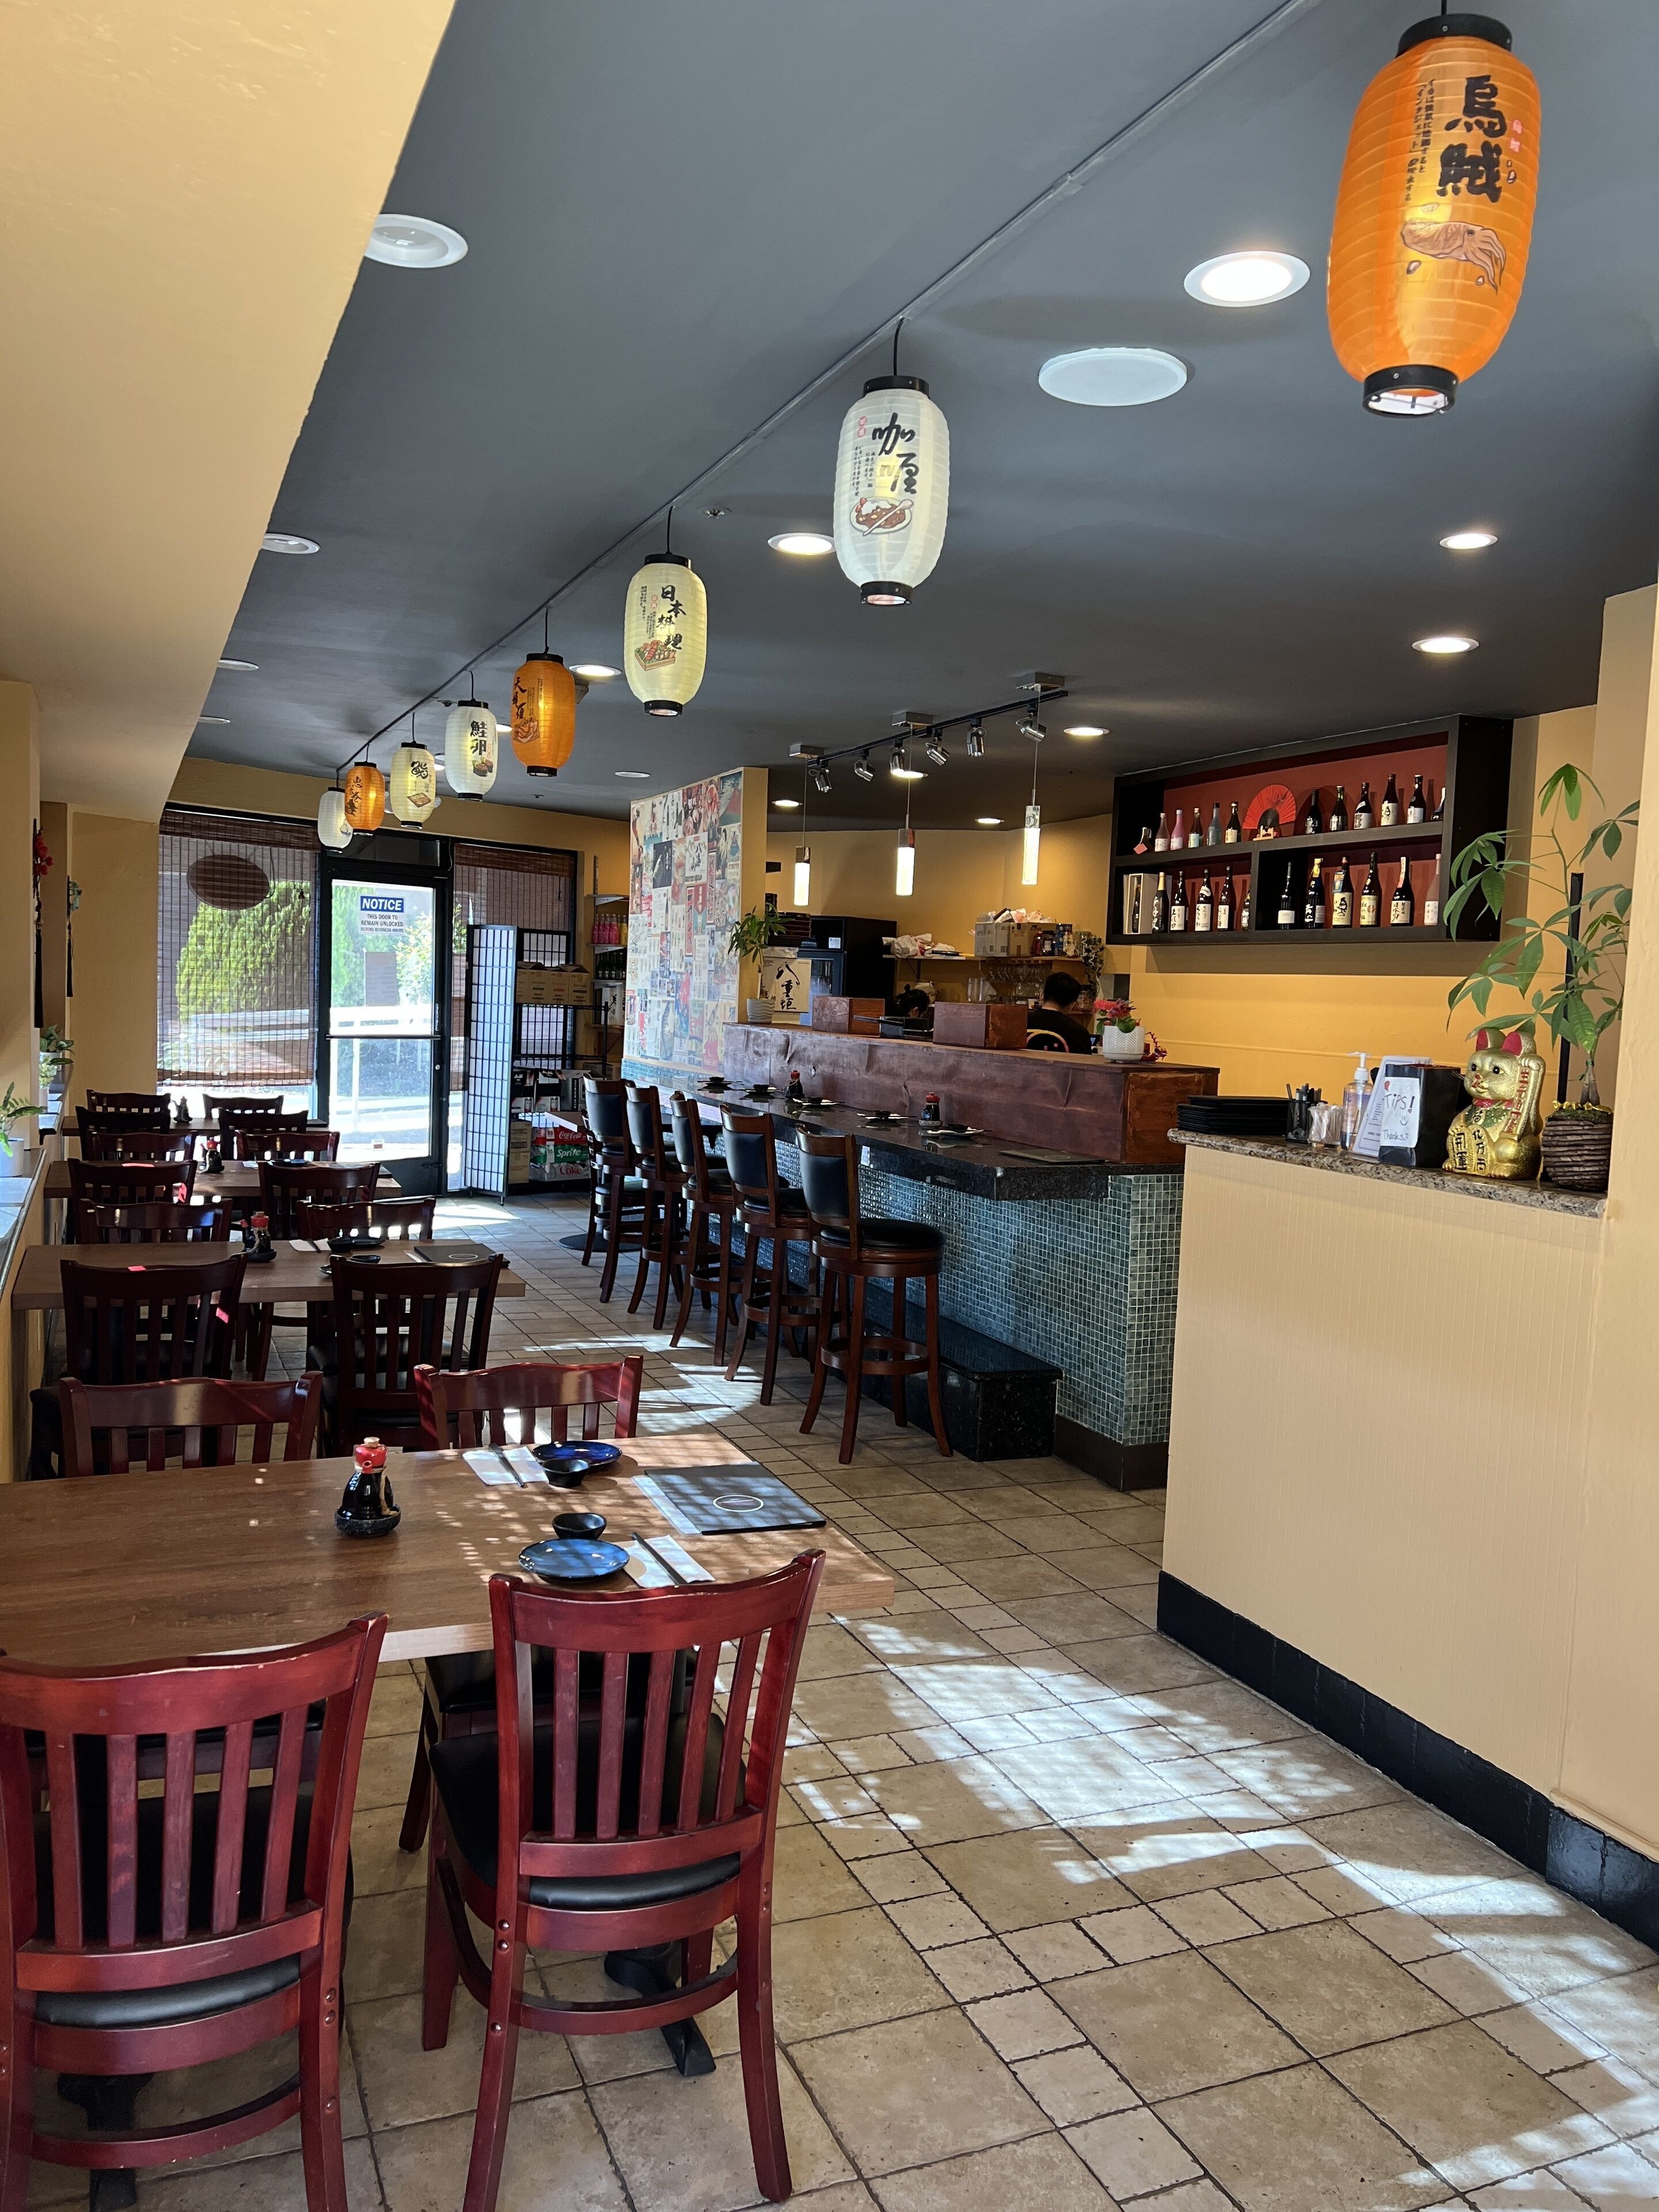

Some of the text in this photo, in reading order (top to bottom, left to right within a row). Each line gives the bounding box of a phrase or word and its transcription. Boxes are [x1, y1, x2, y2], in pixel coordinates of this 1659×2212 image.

[362, 898, 403, 911] NOTICE
[556, 1148, 581, 1158] Sprite
[559, 1164, 581, 1175] Coke
